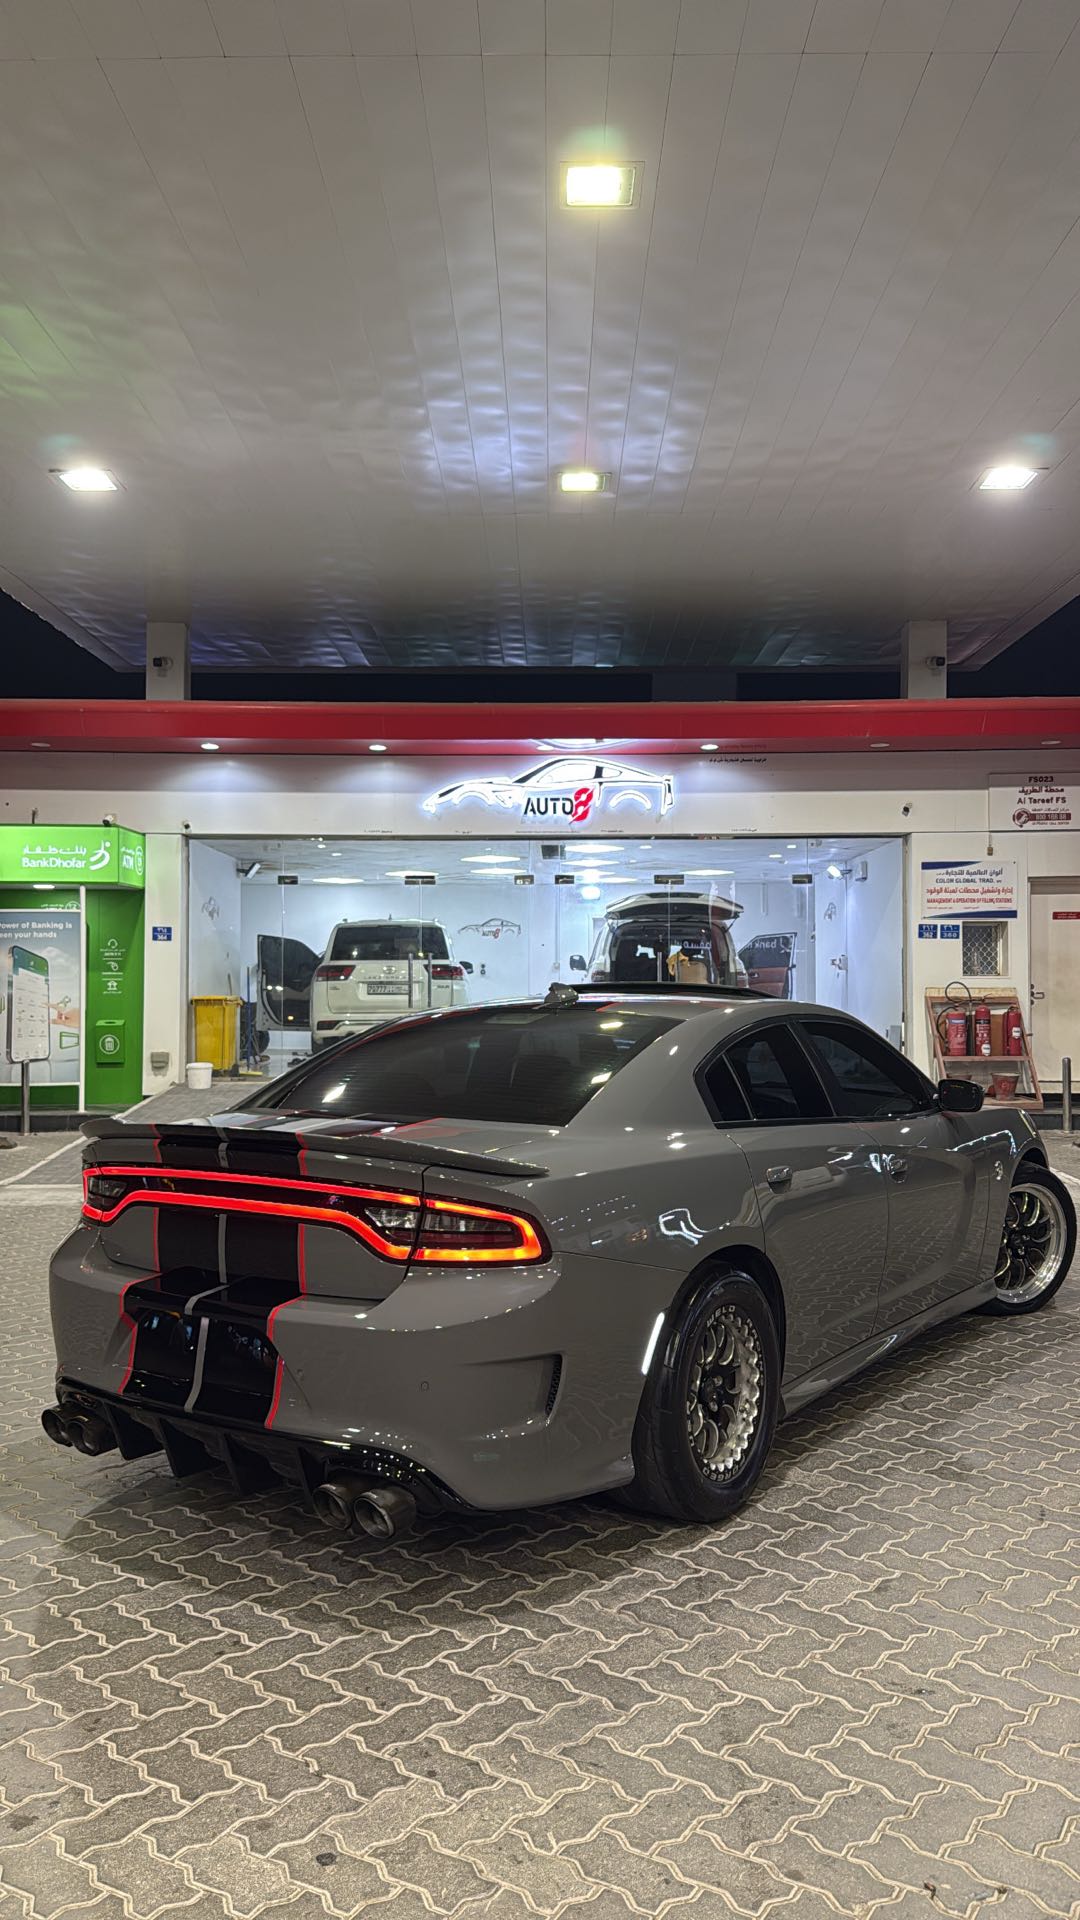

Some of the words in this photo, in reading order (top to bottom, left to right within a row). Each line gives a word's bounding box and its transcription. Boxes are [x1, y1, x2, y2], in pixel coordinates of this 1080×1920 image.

[1044, 785, 1064, 793] محطة
[58, 844, 87, 857] بنك
[22, 856, 87, 868] BankDhofar
[958, 886, 980, 894] محطات
[21, 921, 30, 929] of
[31, 921, 64, 930] Banking
[14, 932, 32, 940] your
[706, 1304, 736, 1328] WELD
